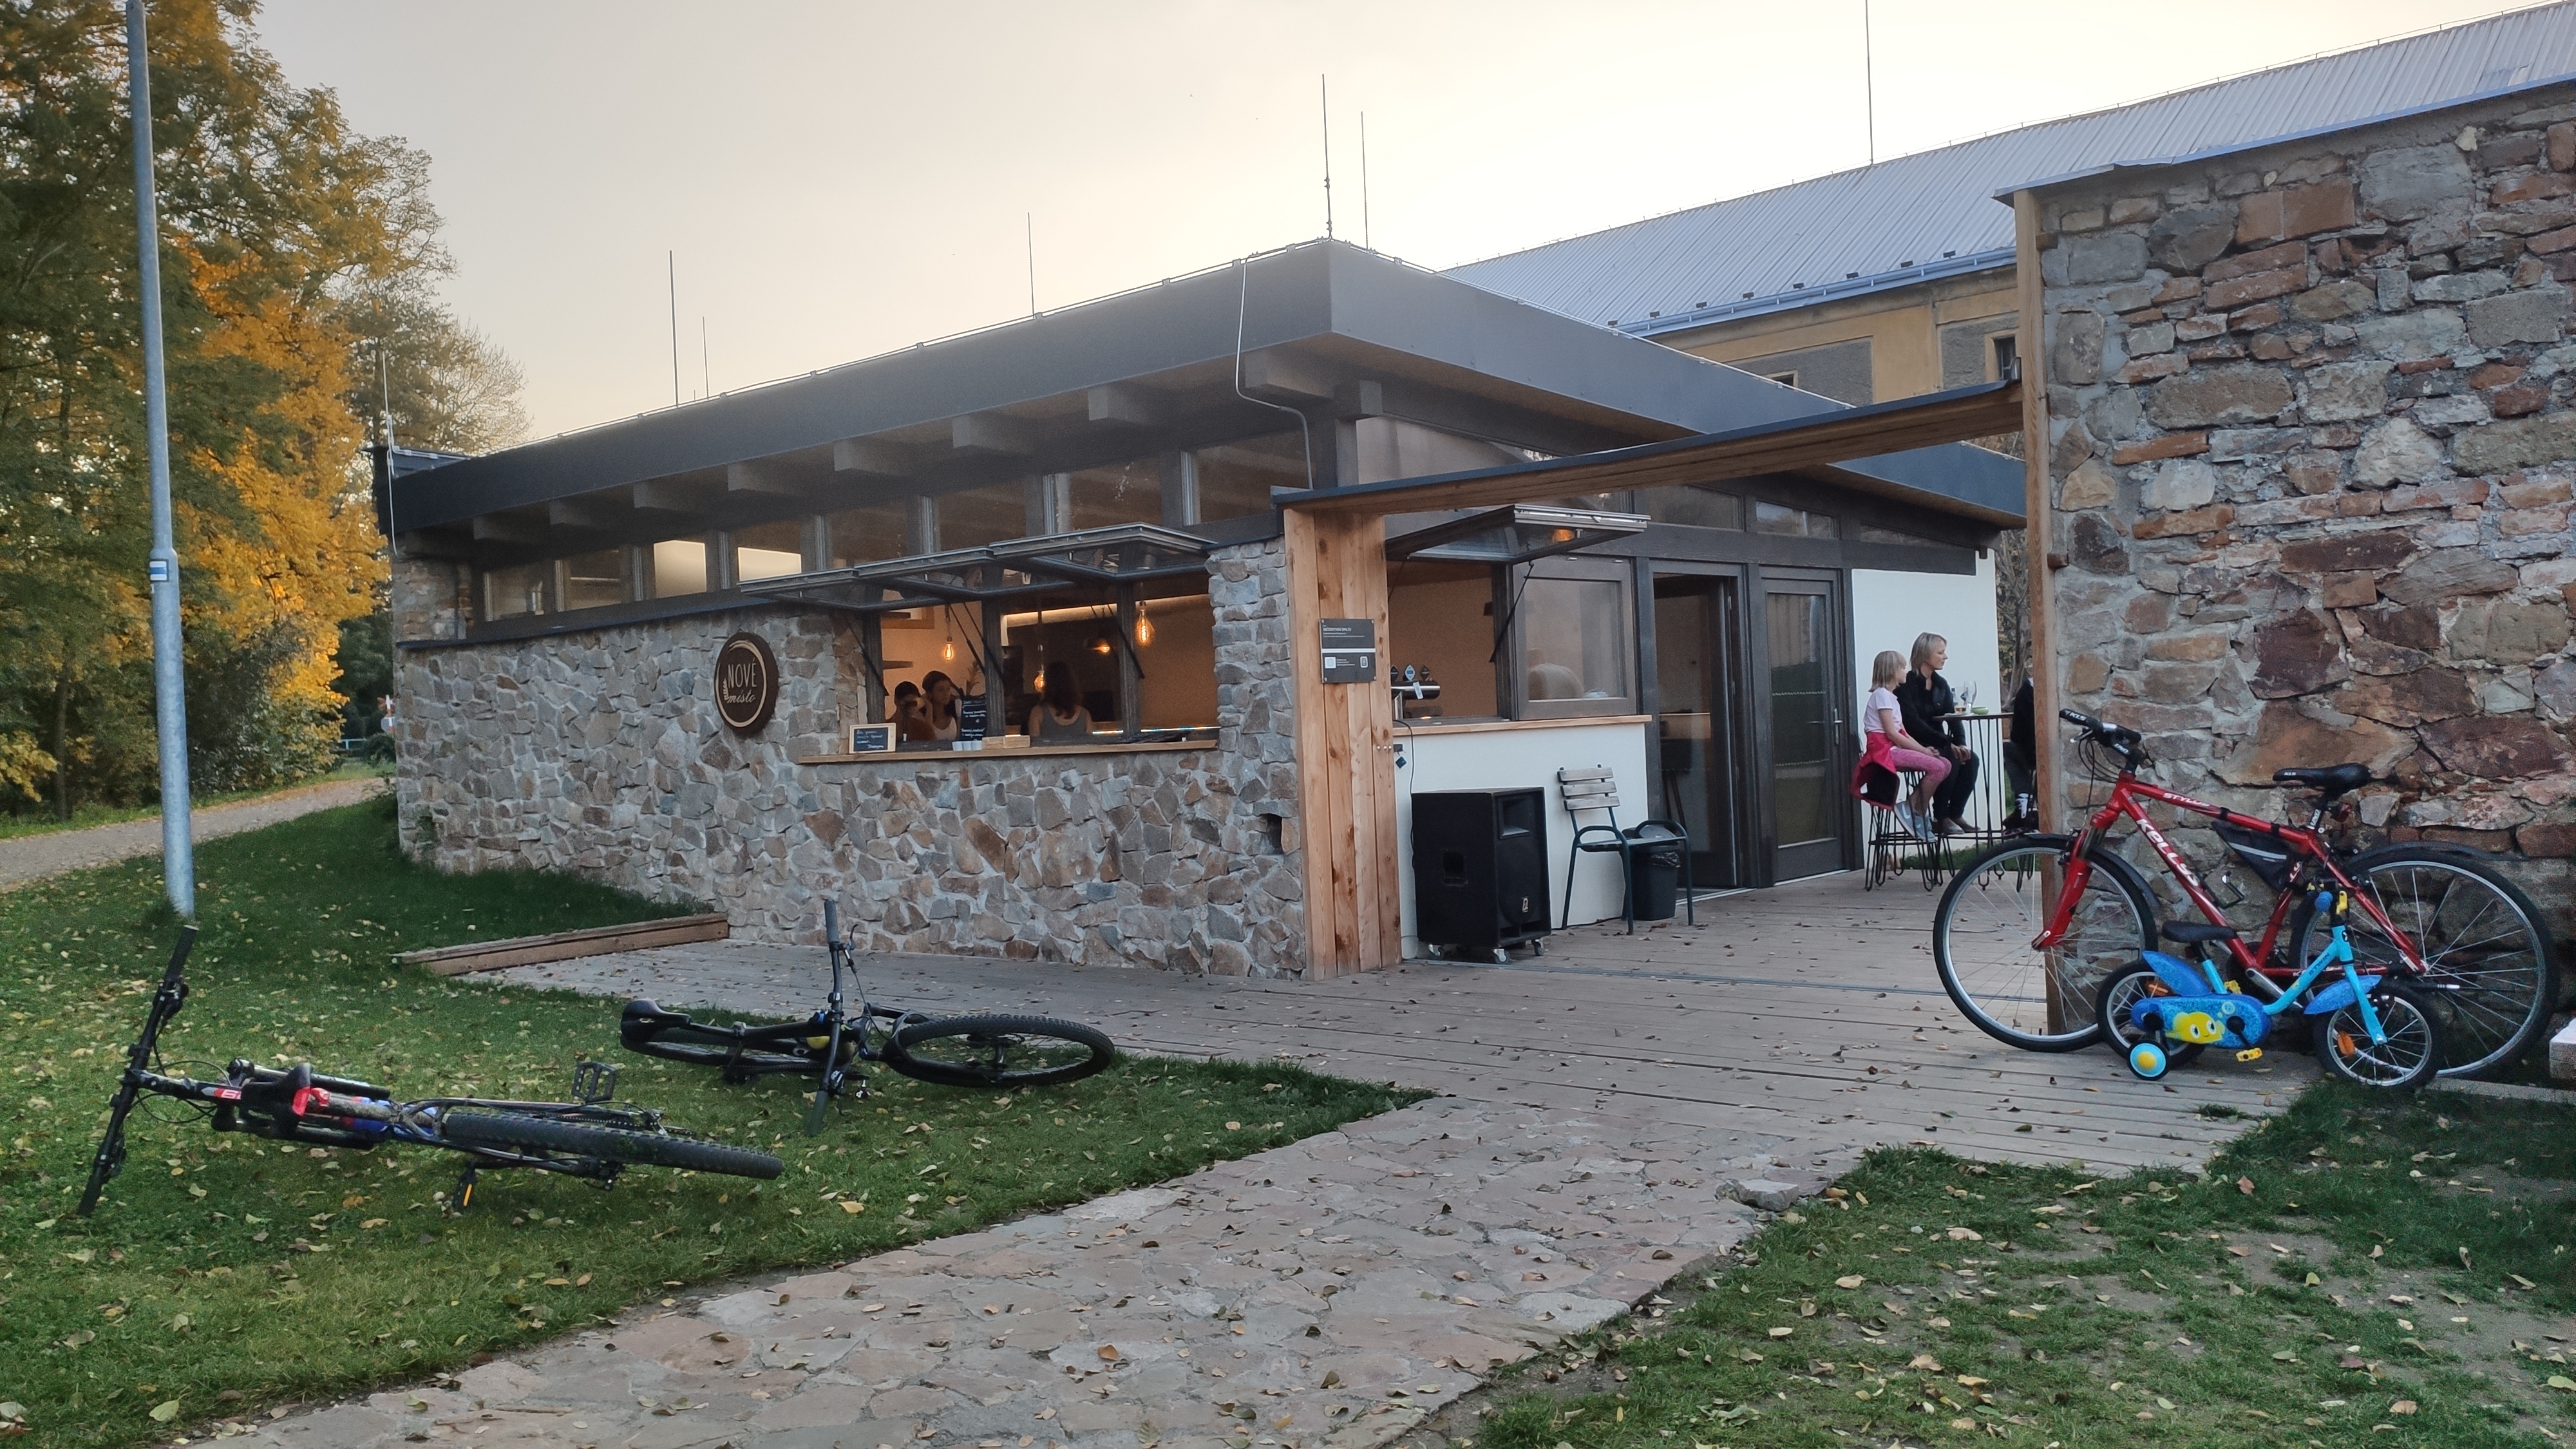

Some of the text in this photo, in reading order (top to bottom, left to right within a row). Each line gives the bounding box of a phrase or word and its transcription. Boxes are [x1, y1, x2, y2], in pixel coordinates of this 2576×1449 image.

[728, 657, 757, 688] NOVÉ
[727, 690, 756, 703] místo
[2070, 712, 2087, 721] KLS
[2163, 793, 2210, 807] STYLUS
